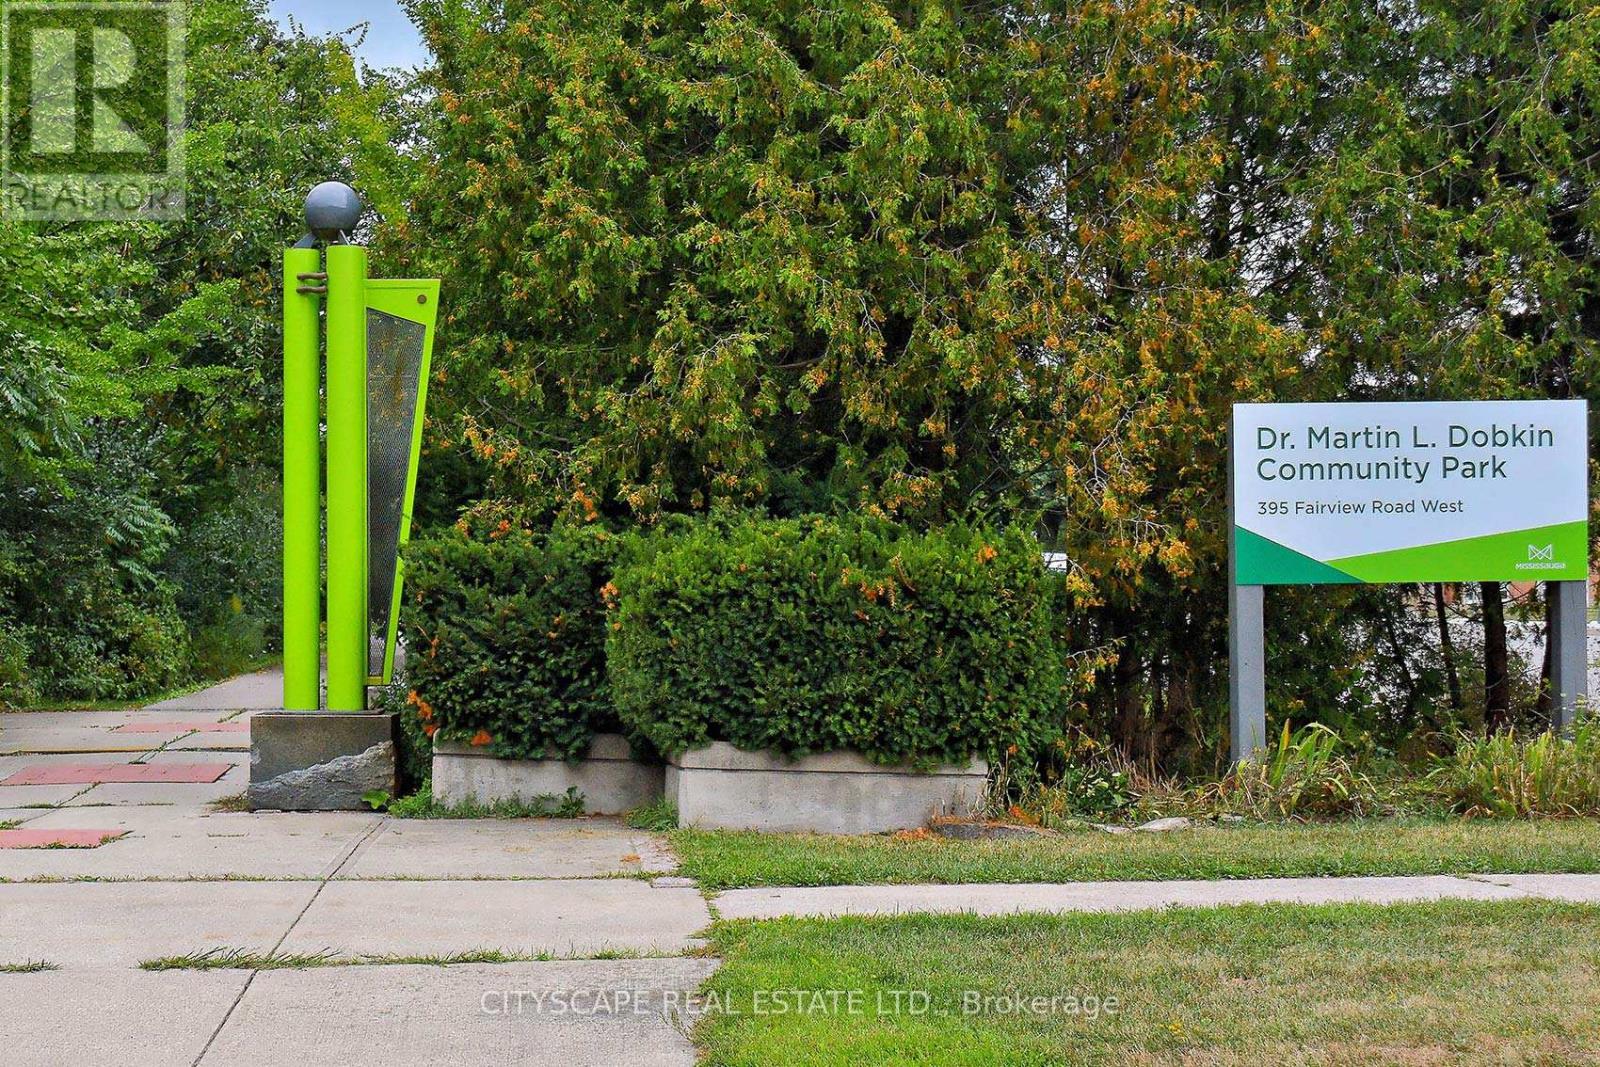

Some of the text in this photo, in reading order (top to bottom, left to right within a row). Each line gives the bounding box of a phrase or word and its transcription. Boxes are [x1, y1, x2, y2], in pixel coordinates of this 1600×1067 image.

[1256, 423, 1554, 450] Dr. Martin L. Dobkin
[1256, 455, 1508, 484] Community Park
[1257, 499, 1464, 515] 395 Fairview Road West
